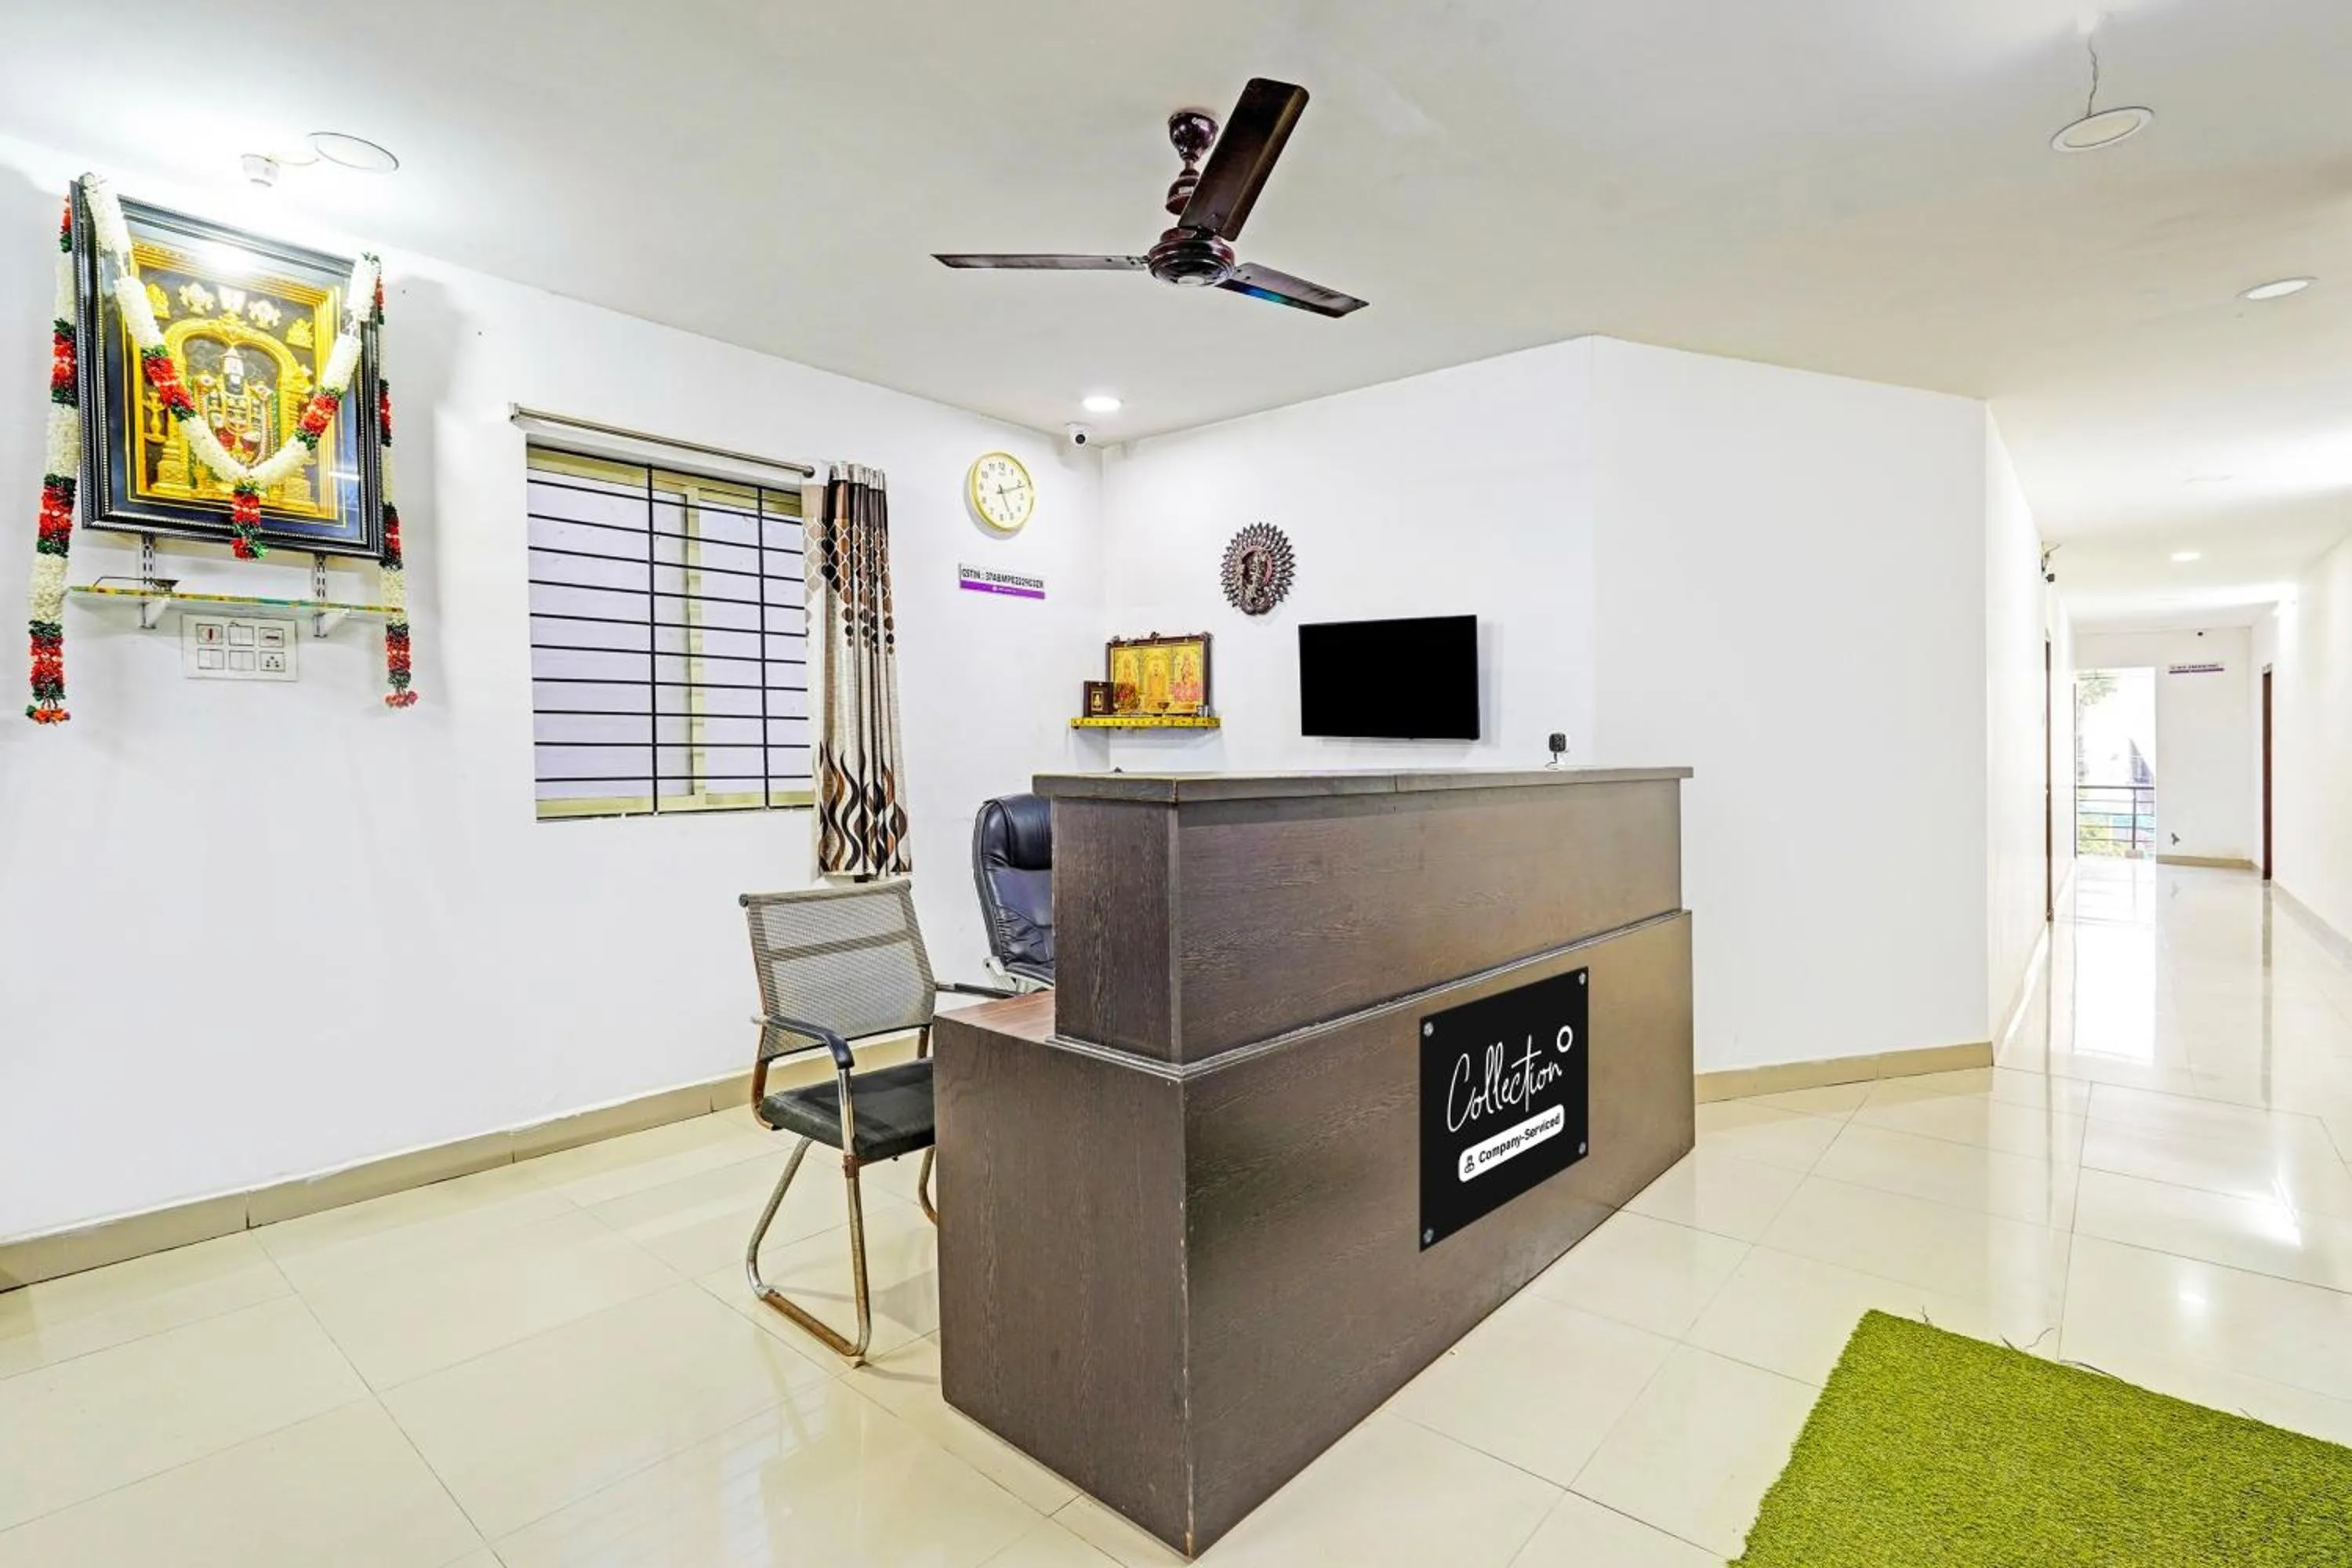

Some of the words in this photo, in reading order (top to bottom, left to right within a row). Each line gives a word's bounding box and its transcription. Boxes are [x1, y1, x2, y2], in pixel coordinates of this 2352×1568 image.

[962, 568, 981, 579] GSTIN
[1446, 1034, 1563, 1133] Collection
[1478, 1112, 1561, 1163] Company-Serviced
